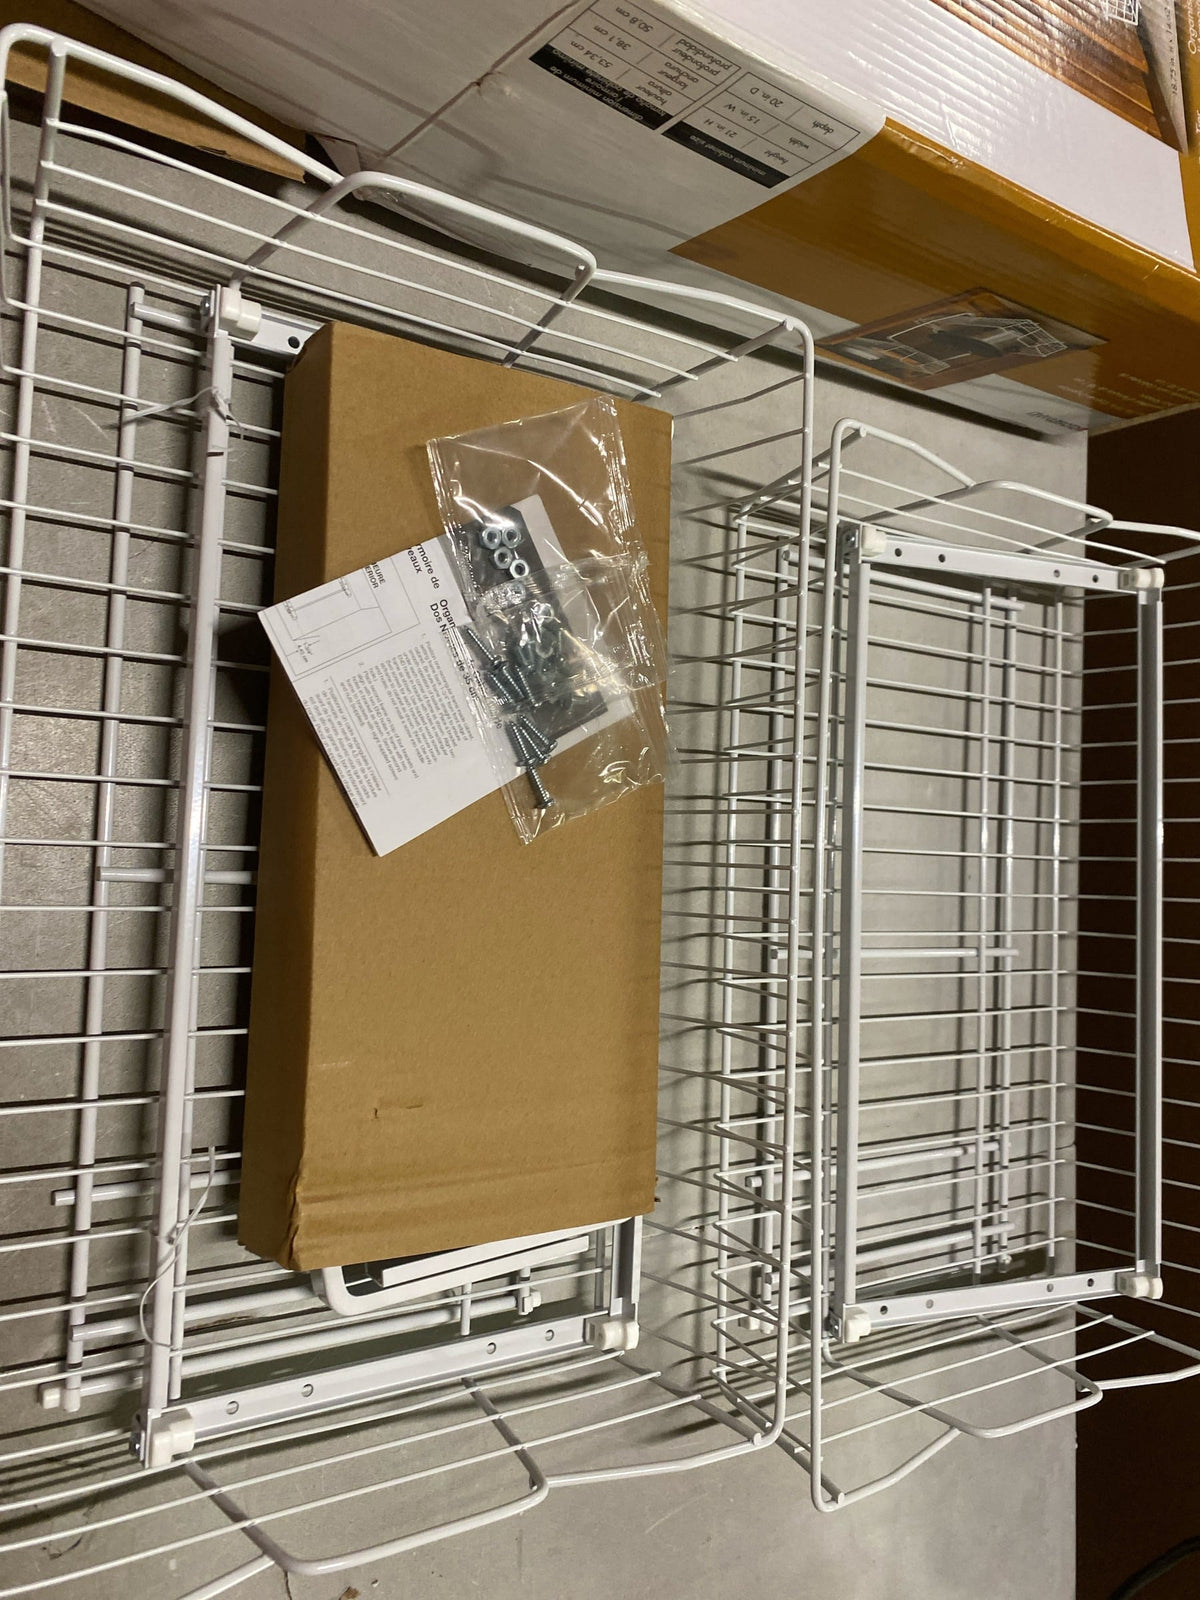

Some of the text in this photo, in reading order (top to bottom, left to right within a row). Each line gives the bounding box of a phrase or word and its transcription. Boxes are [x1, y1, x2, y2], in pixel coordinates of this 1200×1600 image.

[616, 7, 732, 70] profundidad 50,8 cm
[594, 25, 699, 83] anchura 38,1 cm
[672, 48, 720, 76] profondeur
[550, 66, 562, 75] de
[570, 40, 672, 96] altura 53,34 cm
[657, 70, 688, 90] largeur
[635, 86, 668, 106] hauteur
[769, 98, 784, 108] 20
[724, 104, 736, 112] W
[746, 115, 760, 124] 15
[724, 130, 738, 138] 21
[812, 120, 834, 136] depth
[788, 136, 810, 150] width
[764, 150, 789, 166] height
[430, 576, 440, 589] de
[430, 602, 442, 622] Dos
